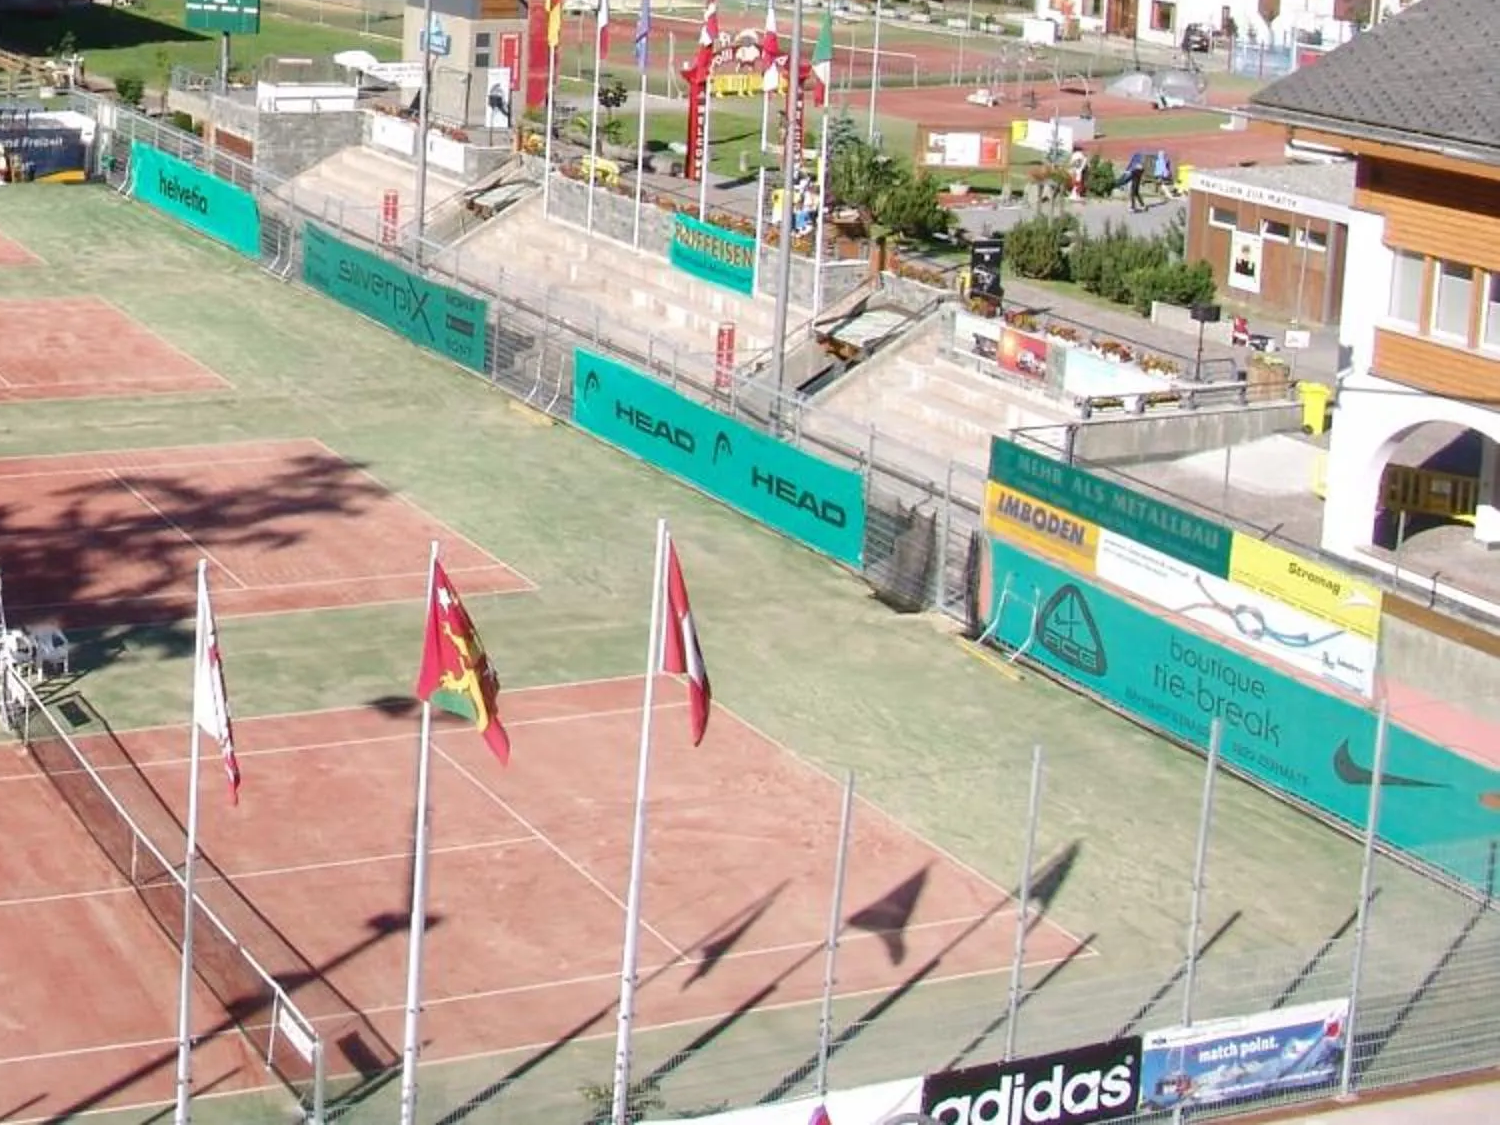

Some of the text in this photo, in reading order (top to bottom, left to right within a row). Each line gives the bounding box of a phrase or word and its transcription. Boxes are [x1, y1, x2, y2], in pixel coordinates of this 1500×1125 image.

[615, 399, 696, 454] HEAD
[752, 466, 847, 528] HEAD
[998, 492, 1086, 546] IMBODEN
[1018, 452, 1220, 550] MEHR ALS METALLBAU
[1288, 560, 1342, 596] Stromag
[1169, 633, 1267, 700] boutique
[1152, 661, 1282, 748] tie-break
[1198, 1040, 1239, 1062] match
[930, 1063, 1132, 1125] adidas
